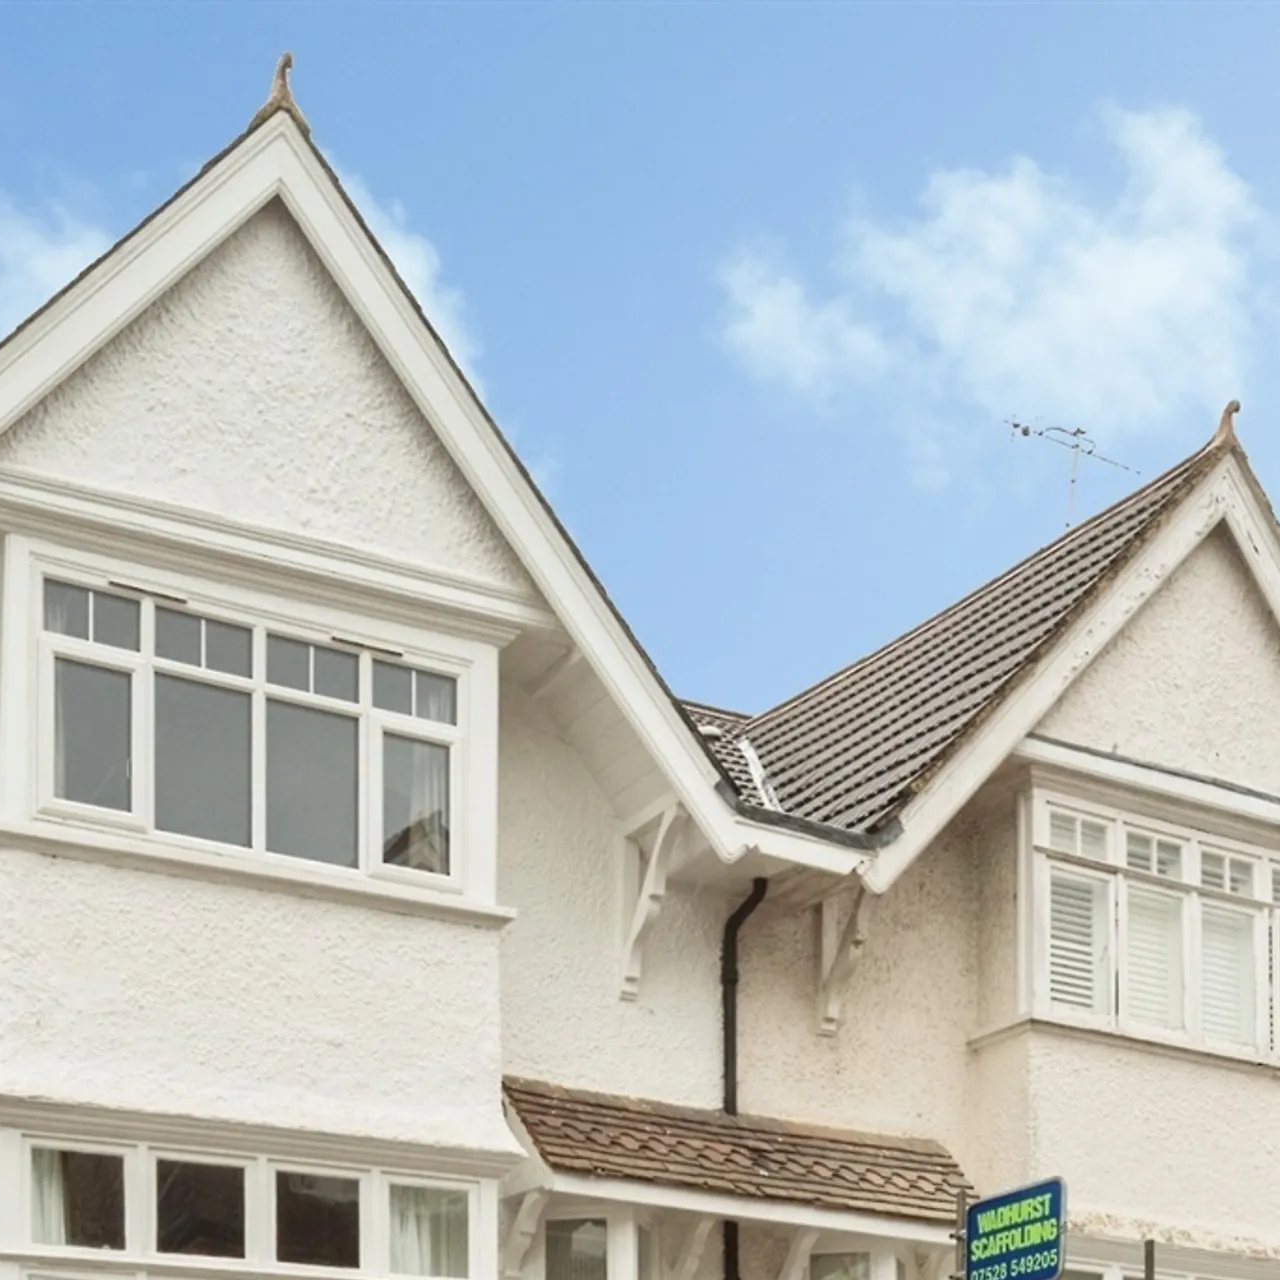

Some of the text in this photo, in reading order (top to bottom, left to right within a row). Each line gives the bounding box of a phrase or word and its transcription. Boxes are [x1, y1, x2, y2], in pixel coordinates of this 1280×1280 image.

[977, 1192, 1052, 1234] WADHURST
[970, 1218, 1058, 1261] SCAFFOLDING
[1010, 1249, 1058, 1276] 549205
